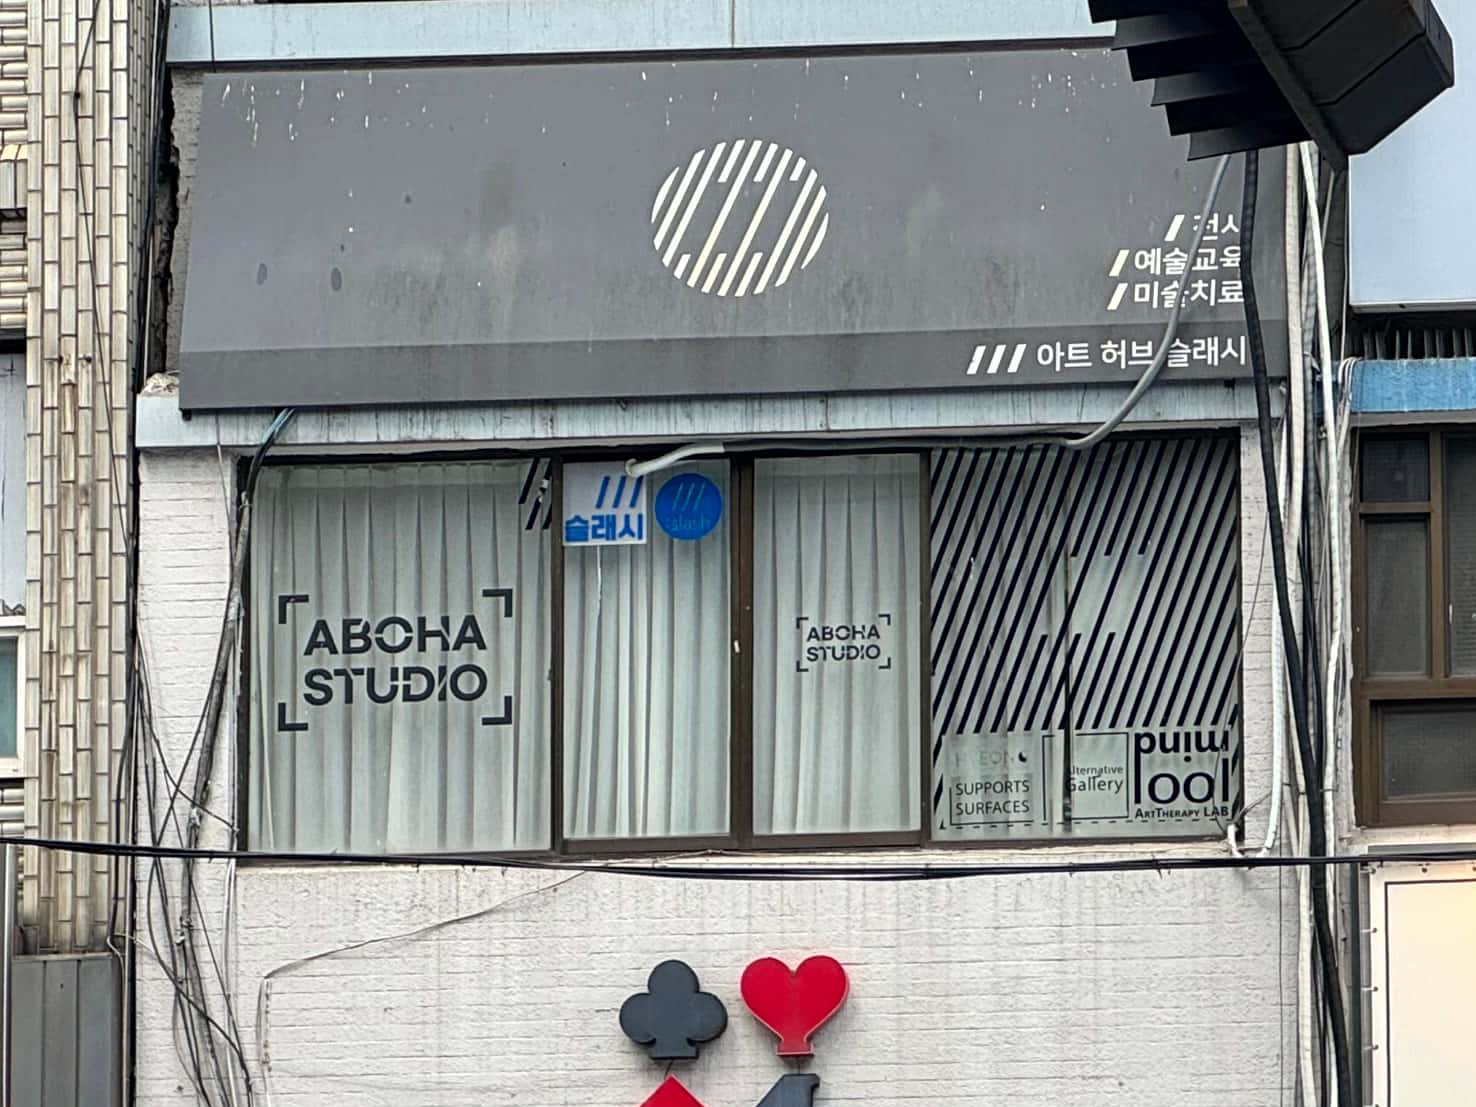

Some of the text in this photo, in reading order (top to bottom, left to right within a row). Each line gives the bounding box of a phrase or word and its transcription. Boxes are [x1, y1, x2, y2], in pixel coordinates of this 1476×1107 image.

[1134, 245, 1242, 276] 예술교육
[1133, 279, 1245, 309] 미술치료
[1035, 335, 1247, 374] 아트 허브 슬래시
[564, 512, 645, 543] 슬래시
[302, 612, 488, 656] ABOHA
[806, 622, 882, 643] ABOHA
[805, 643, 883, 664] STUDIO
[302, 662, 490, 707] STUDIO
[955, 779, 1031, 797] SUPPORTS
[955, 799, 1031, 817] SURFACES
[1203, 806, 1230, 817] LAB
